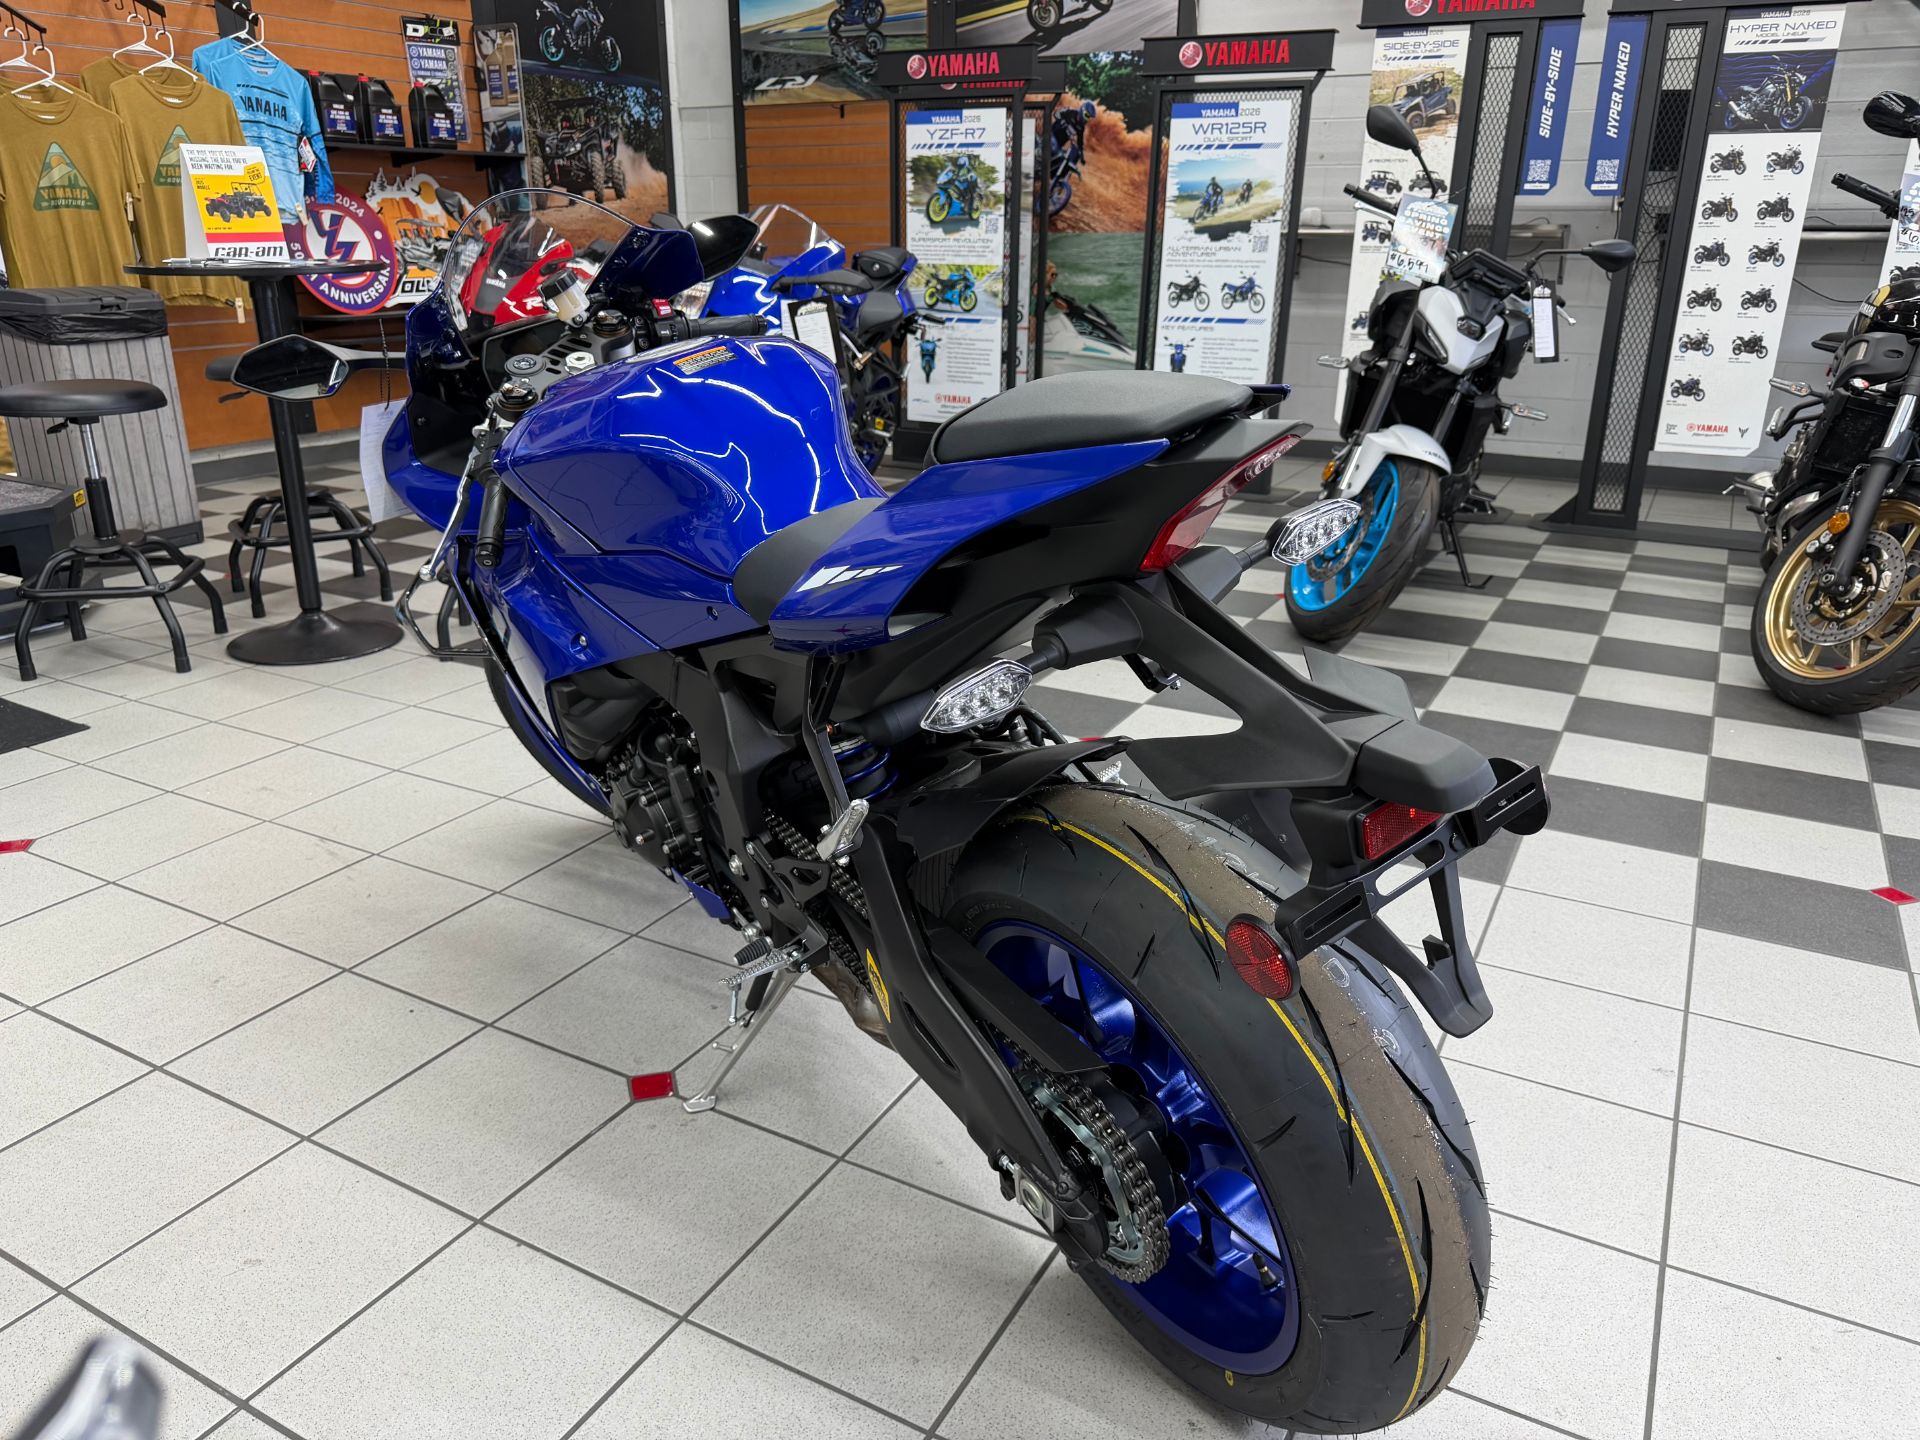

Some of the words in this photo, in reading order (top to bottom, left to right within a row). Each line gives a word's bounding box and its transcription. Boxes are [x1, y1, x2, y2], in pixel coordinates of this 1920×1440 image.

[1730, 23, 1780, 34] HYPER
[1784, 20, 1837, 31] NAKED
[1383, 39, 1460, 51] SIDE-BY-SIDE
[418, 47, 446, 59] YAMAHA
[1205, 39, 1290, 66] YAMAHA
[420, 58, 448, 70] YAMAHA
[927, 51, 1000, 77] YAMAHA
[1613, 41, 1631, 91] NAKED
[1538, 46, 1563, 139] SIDE-BY-SIDE
[931, 115, 961, 124] YAMAHA
[1200, 107, 1237, 118] YAMAHA
[1239, 107, 1261, 117] 2026
[1606, 91, 1624, 139] HYPER
[926, 127, 987, 140] YZF-R7
[1192, 121, 1267, 135] WR125R
[40, 187, 90, 200] YAMAHA
[335, 192, 365, 218] 2024
[214, 245, 284, 259] can-am
[1697, 423, 1729, 433] YAMAHA
